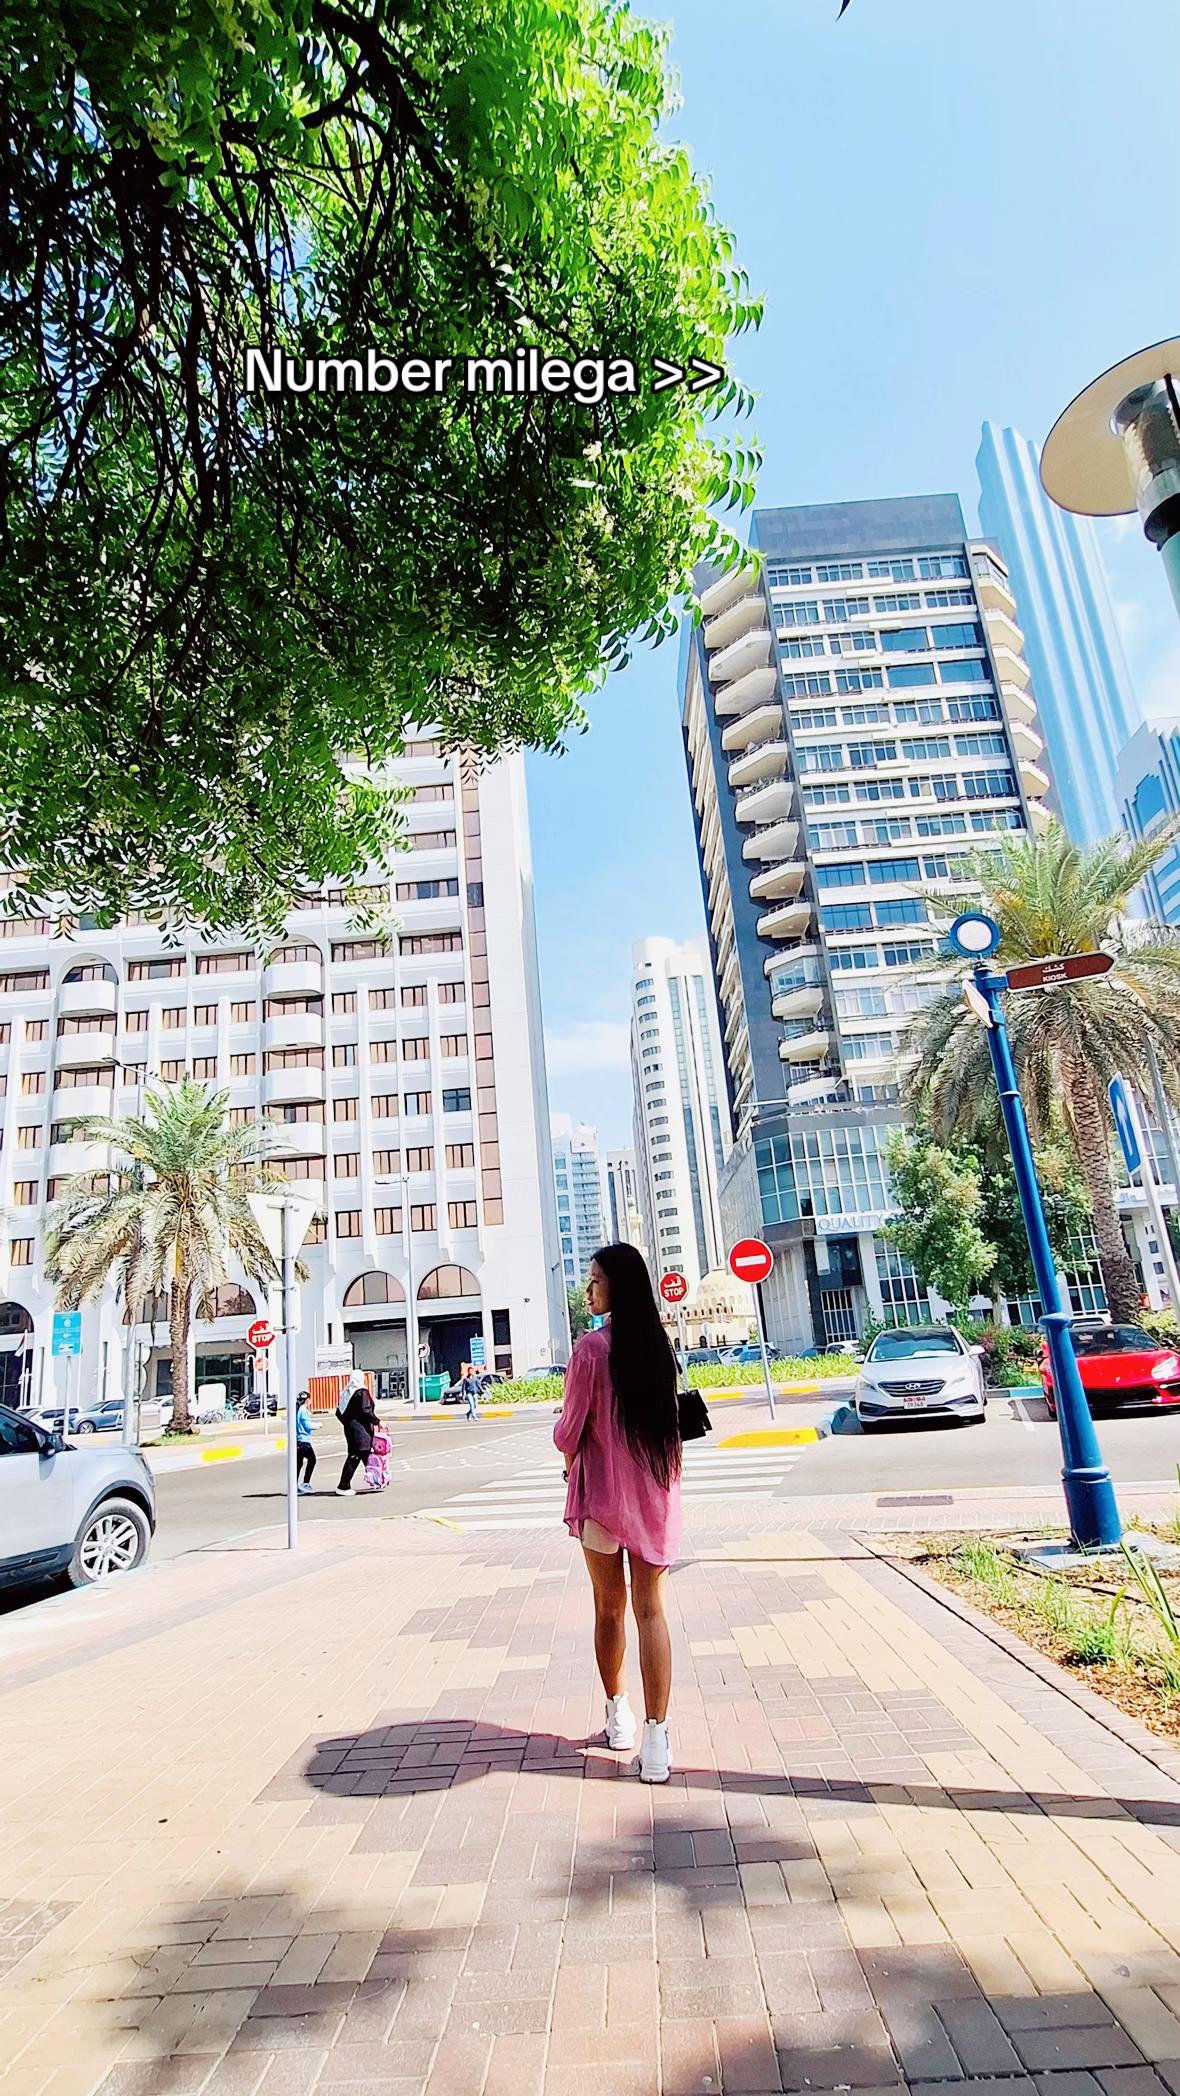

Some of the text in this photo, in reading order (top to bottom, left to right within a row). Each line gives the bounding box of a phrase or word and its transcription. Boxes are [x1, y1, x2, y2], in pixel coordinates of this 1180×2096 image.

[1041, 963, 1065, 973] كشك
[1042, 972, 1067, 982] KIOSK
[818, 1214, 885, 1232] QUALITY
[664, 1276, 682, 1288] قف
[664, 1287, 685, 1297] STOP
[251, 1334, 273, 1343] STOP
